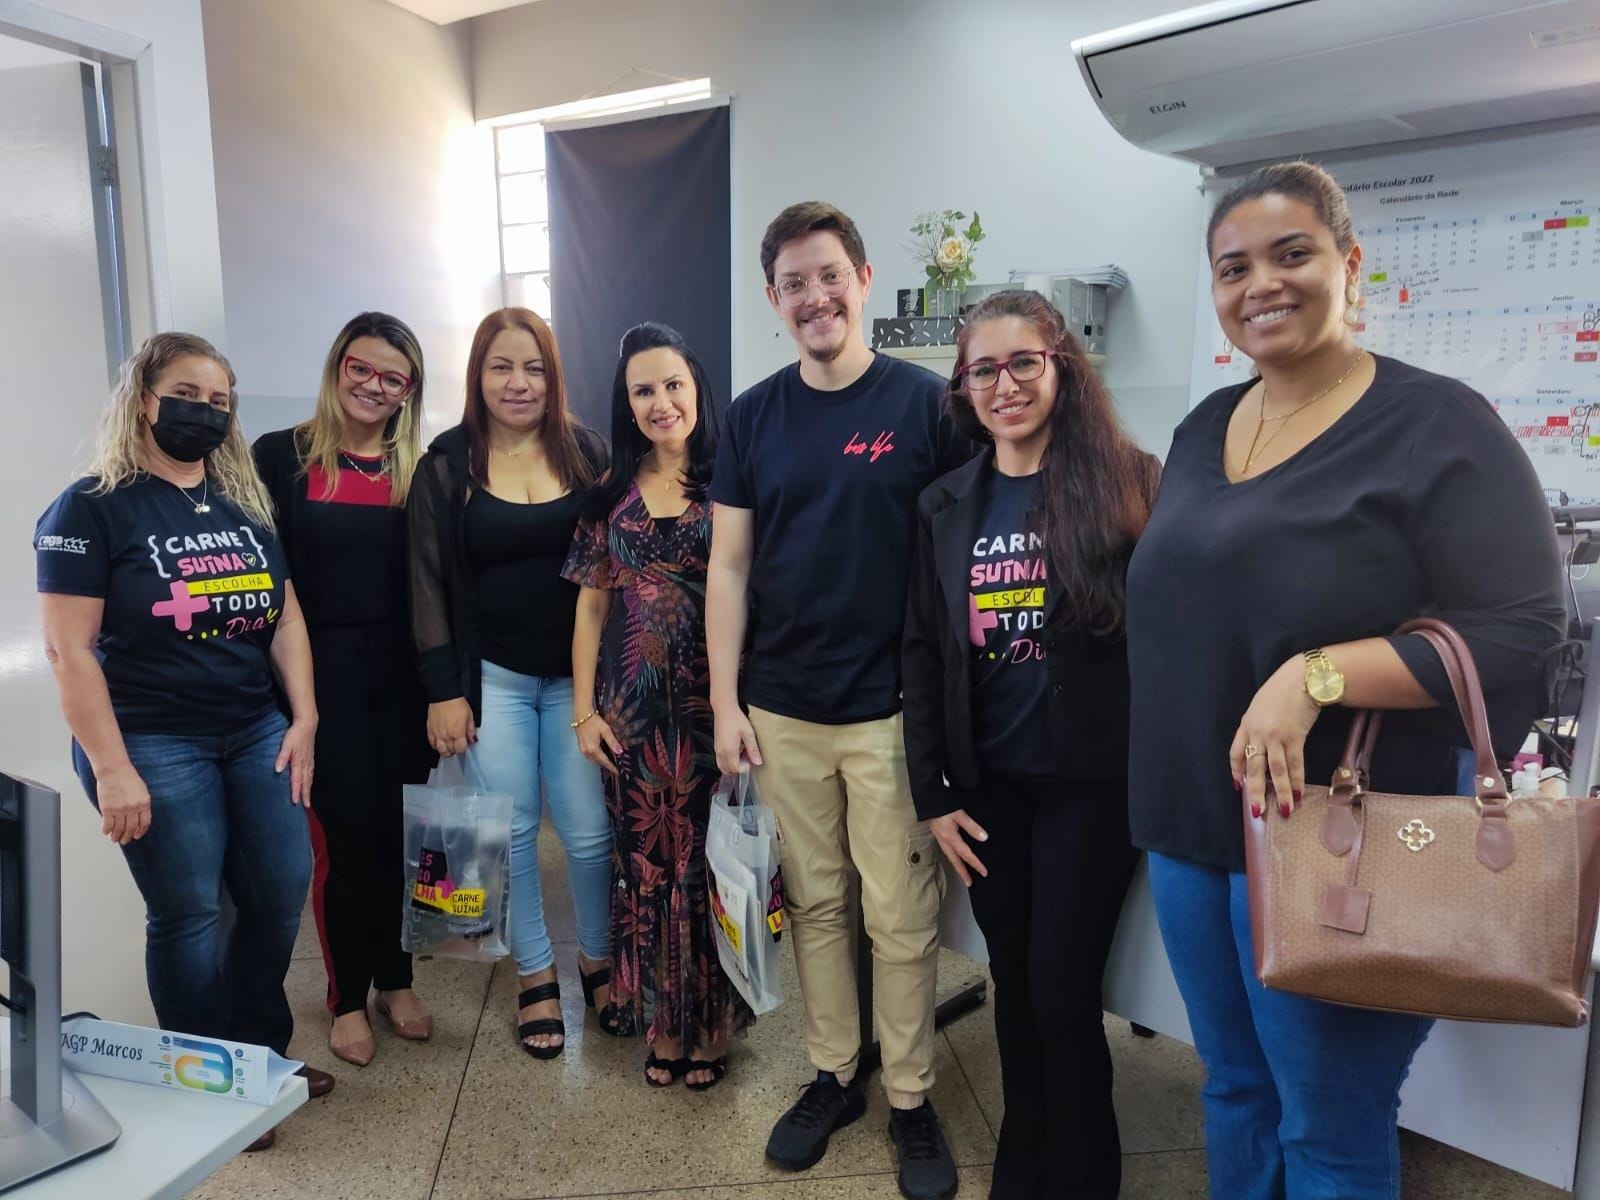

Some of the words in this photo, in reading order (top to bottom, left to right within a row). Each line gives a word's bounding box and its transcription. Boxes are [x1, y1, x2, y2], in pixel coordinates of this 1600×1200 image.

[1148, 100, 1187, 115] ELGIN
[1342, 182, 1371, 193] ndário
[1372, 178, 1408, 190] Escolar
[1409, 174, 1435, 185] 2022
[1379, 193, 1424, 205] Calendário
[165, 530, 243, 554] CARNE
[972, 532, 1047, 557] CARN
[203, 576, 265, 592] ESCOLHA
[211, 592, 271, 614] TODO
[991, 587, 1042, 606] ESCOL
[225, 615, 267, 640] Dia
[998, 610, 1044, 632] TOD
[1010, 638, 1047, 664] Di
[452, 893, 481, 903] CARNE
[61, 1032, 89, 1054] AGP
[90, 1037, 143, 1061] Marcos
